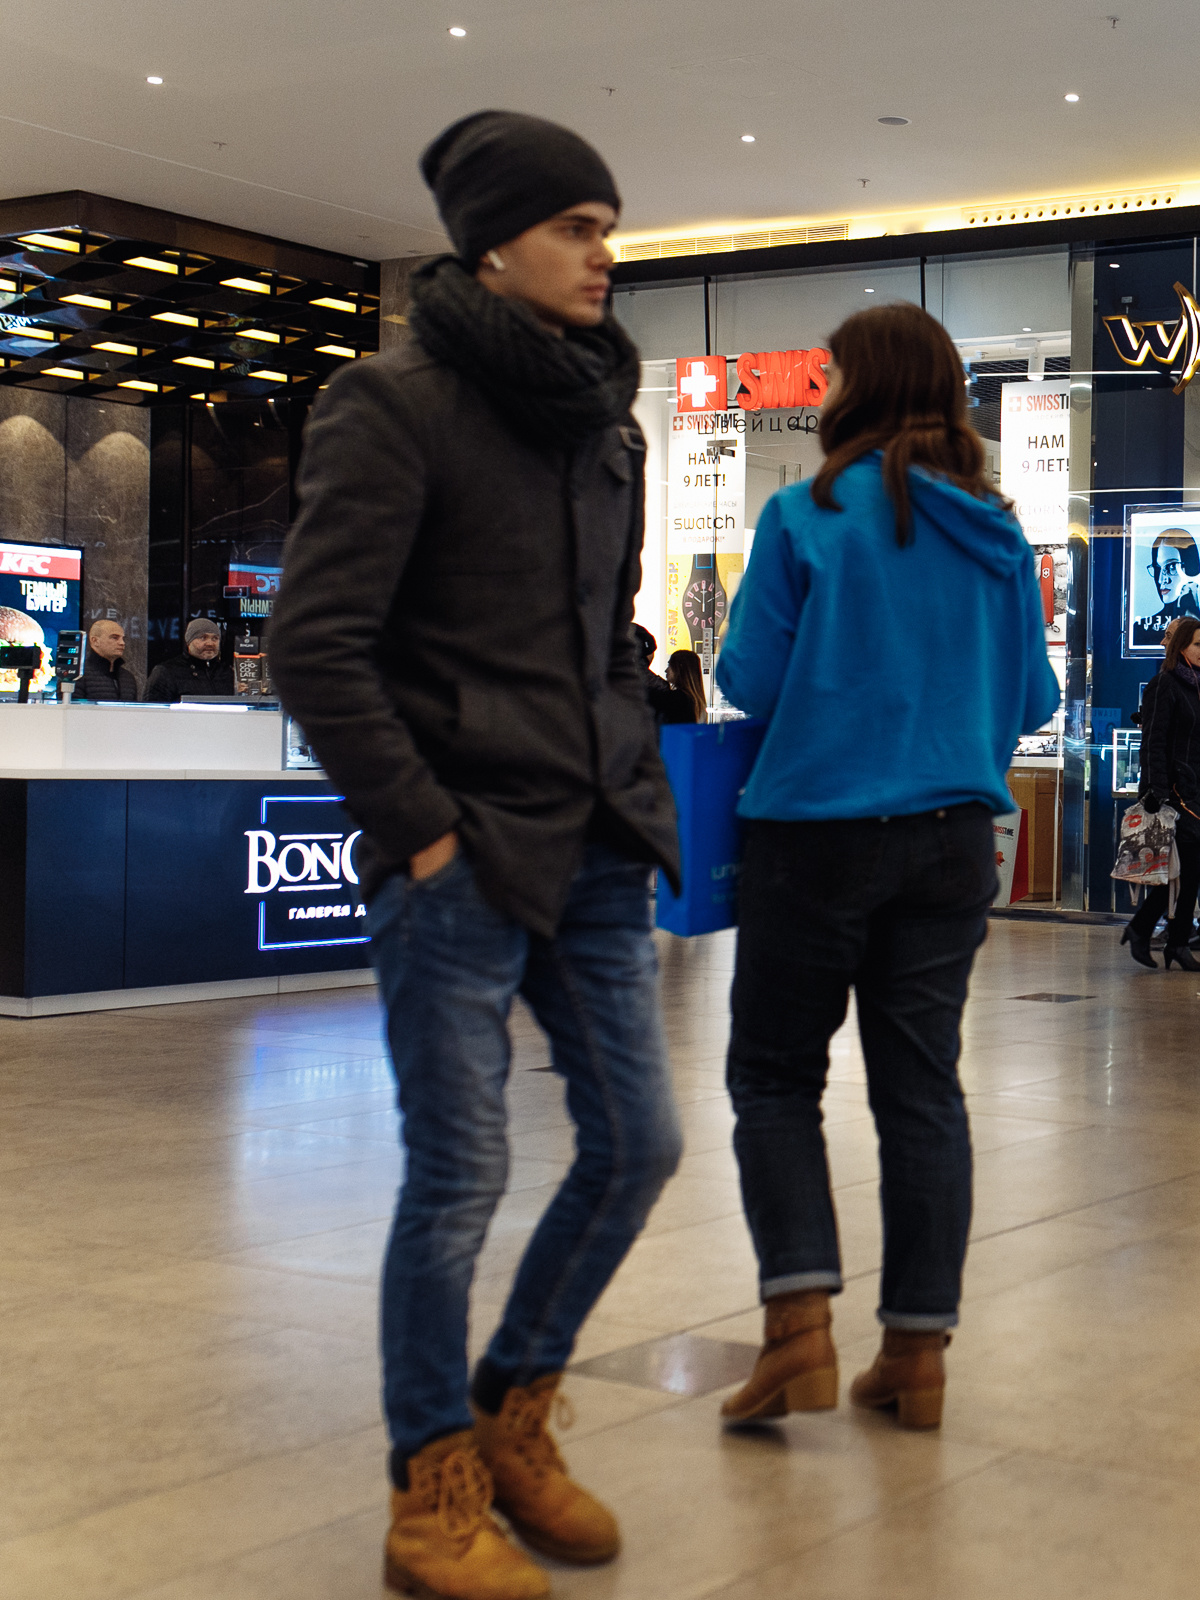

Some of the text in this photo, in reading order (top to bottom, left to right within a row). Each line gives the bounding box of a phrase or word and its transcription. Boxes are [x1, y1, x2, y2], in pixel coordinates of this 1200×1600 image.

[736, 347, 832, 412] SWIS
[1026, 393, 1069, 412] SWISSTI
[687, 413, 739, 431] SWISSTIME
[697, 413, 818, 435] швейцар
[1028, 434, 1064, 449] НАМ
[688, 452, 721, 465] НАМ
[1022, 458, 1069, 473] 9 ЛЕТ!
[683, 474, 726, 487] 9 ЛЕТ!
[674, 513, 735, 530] swatch
[1, 552, 51, 575] KFC
[19, 580, 67, 598] ТЕМНЫЙ
[26, 597, 67, 613] БУРГЕР
[288, 904, 367, 920] ГАЛЕРЕЯ Д
